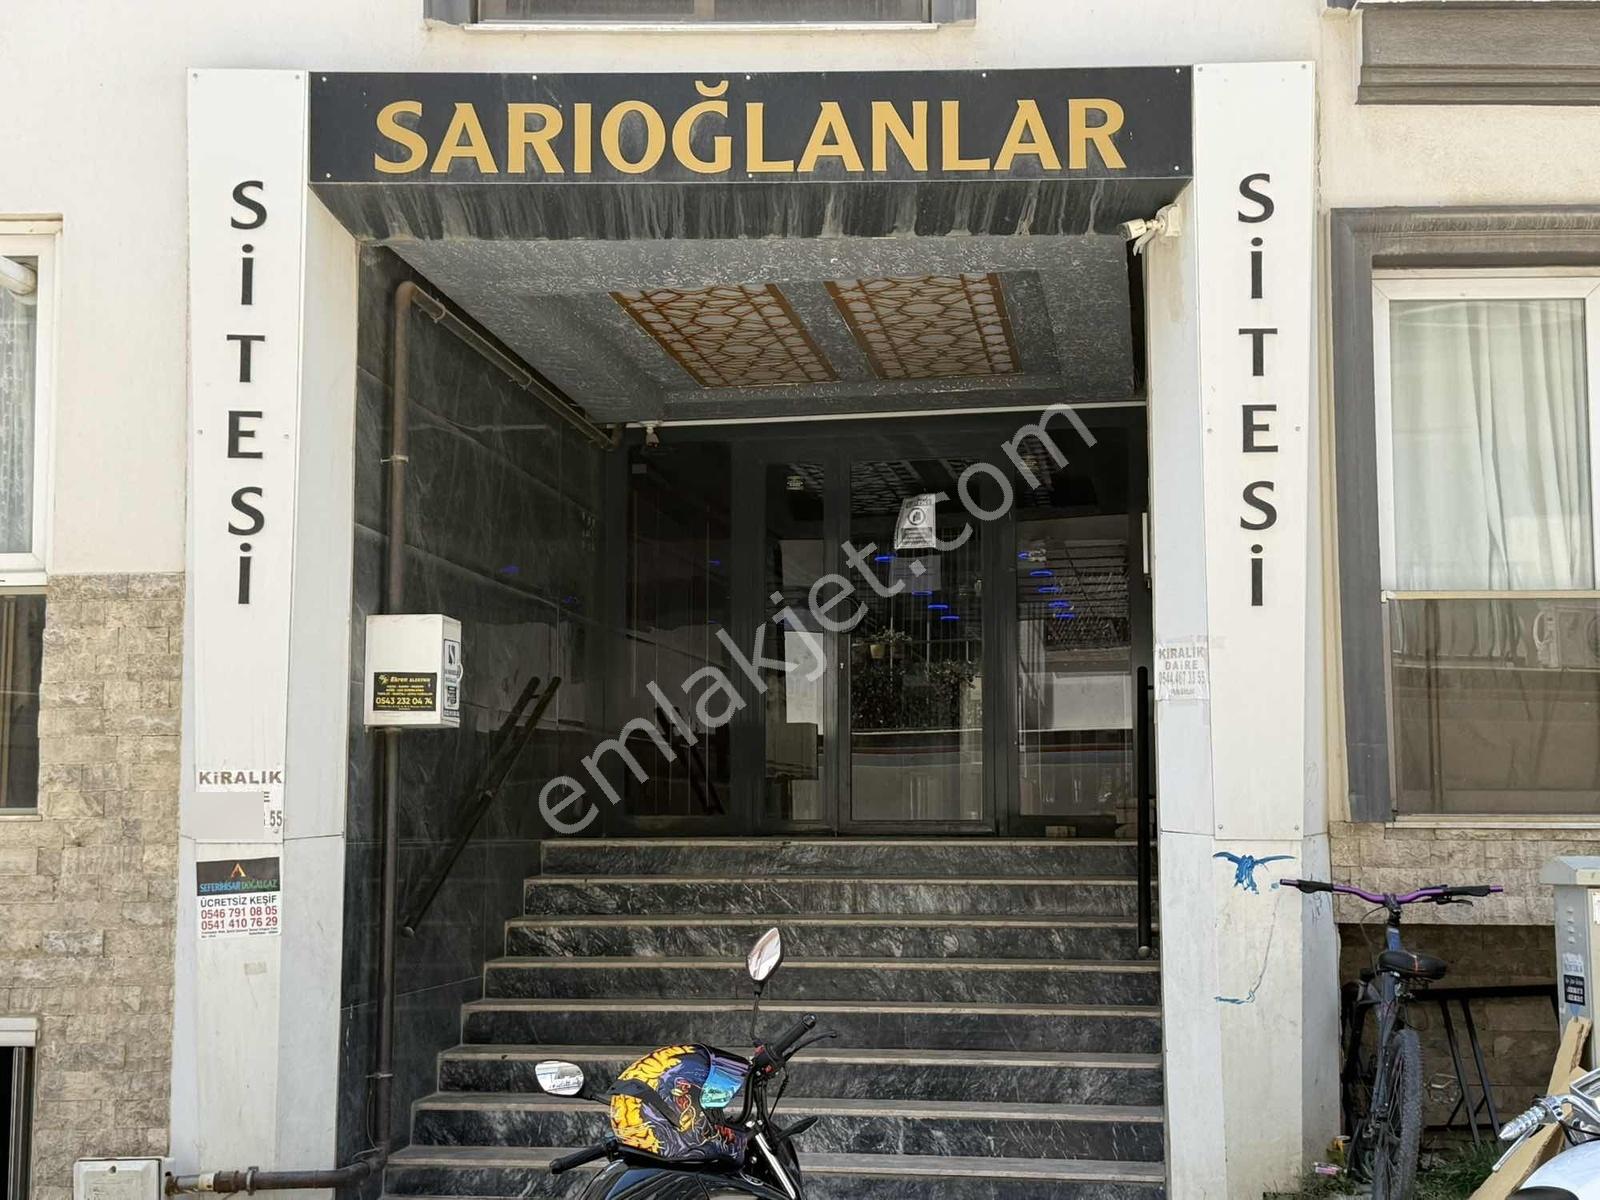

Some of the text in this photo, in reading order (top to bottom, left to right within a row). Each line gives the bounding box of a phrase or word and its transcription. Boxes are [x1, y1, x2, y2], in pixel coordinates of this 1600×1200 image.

[375, 80, 1125, 174] SARIOĞLANLAR
[227, 180, 267, 605] SİTESİ
[1239, 173, 1279, 606] SİTESİ
[375, 697, 396, 705] 0543
[396, 697, 411, 705] 232
[200, 894, 277, 908] ÜCRETSİZ KEŞİF
[201, 905, 278, 920] 0546 791 08 05
[201, 916, 279, 931] 0541 410 76 29
